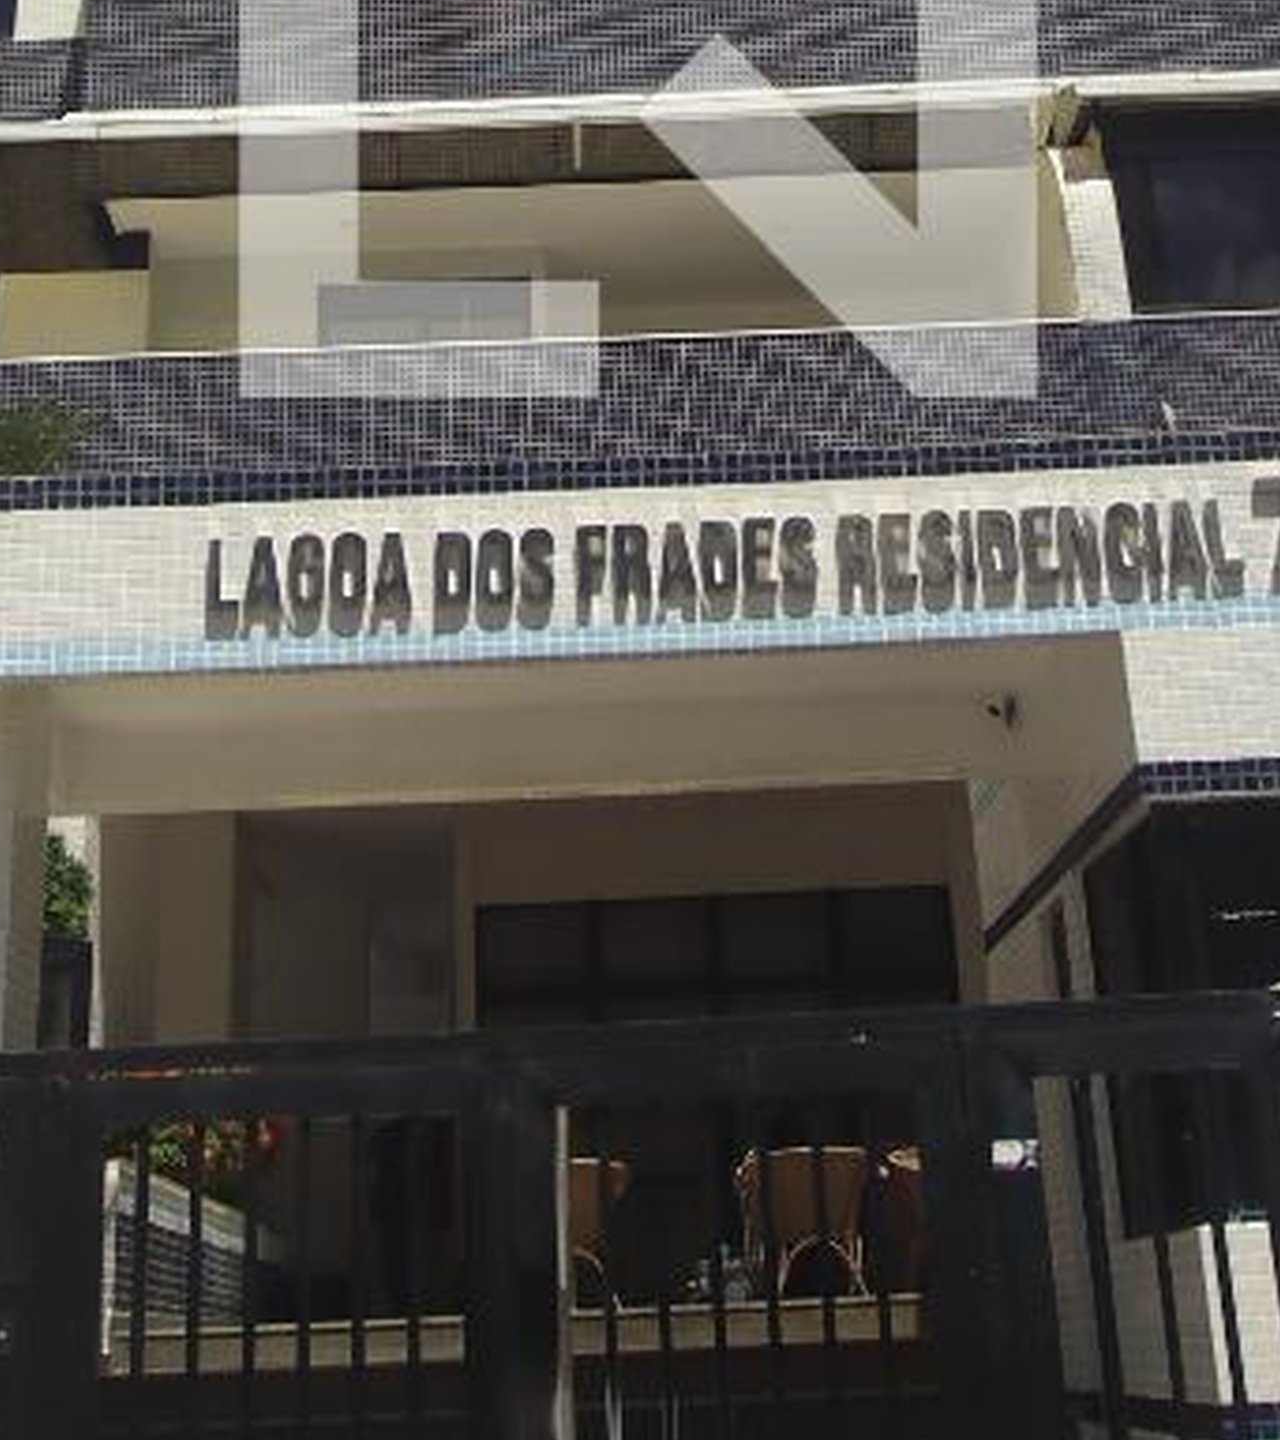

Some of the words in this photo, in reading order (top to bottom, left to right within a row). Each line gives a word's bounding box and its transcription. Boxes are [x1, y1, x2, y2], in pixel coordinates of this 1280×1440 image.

[204, 530, 413, 641] LAGOA
[432, 527, 556, 636] DOS
[574, 514, 818, 628] FRADES
[834, 498, 1245, 616] RESIDENCIAL
